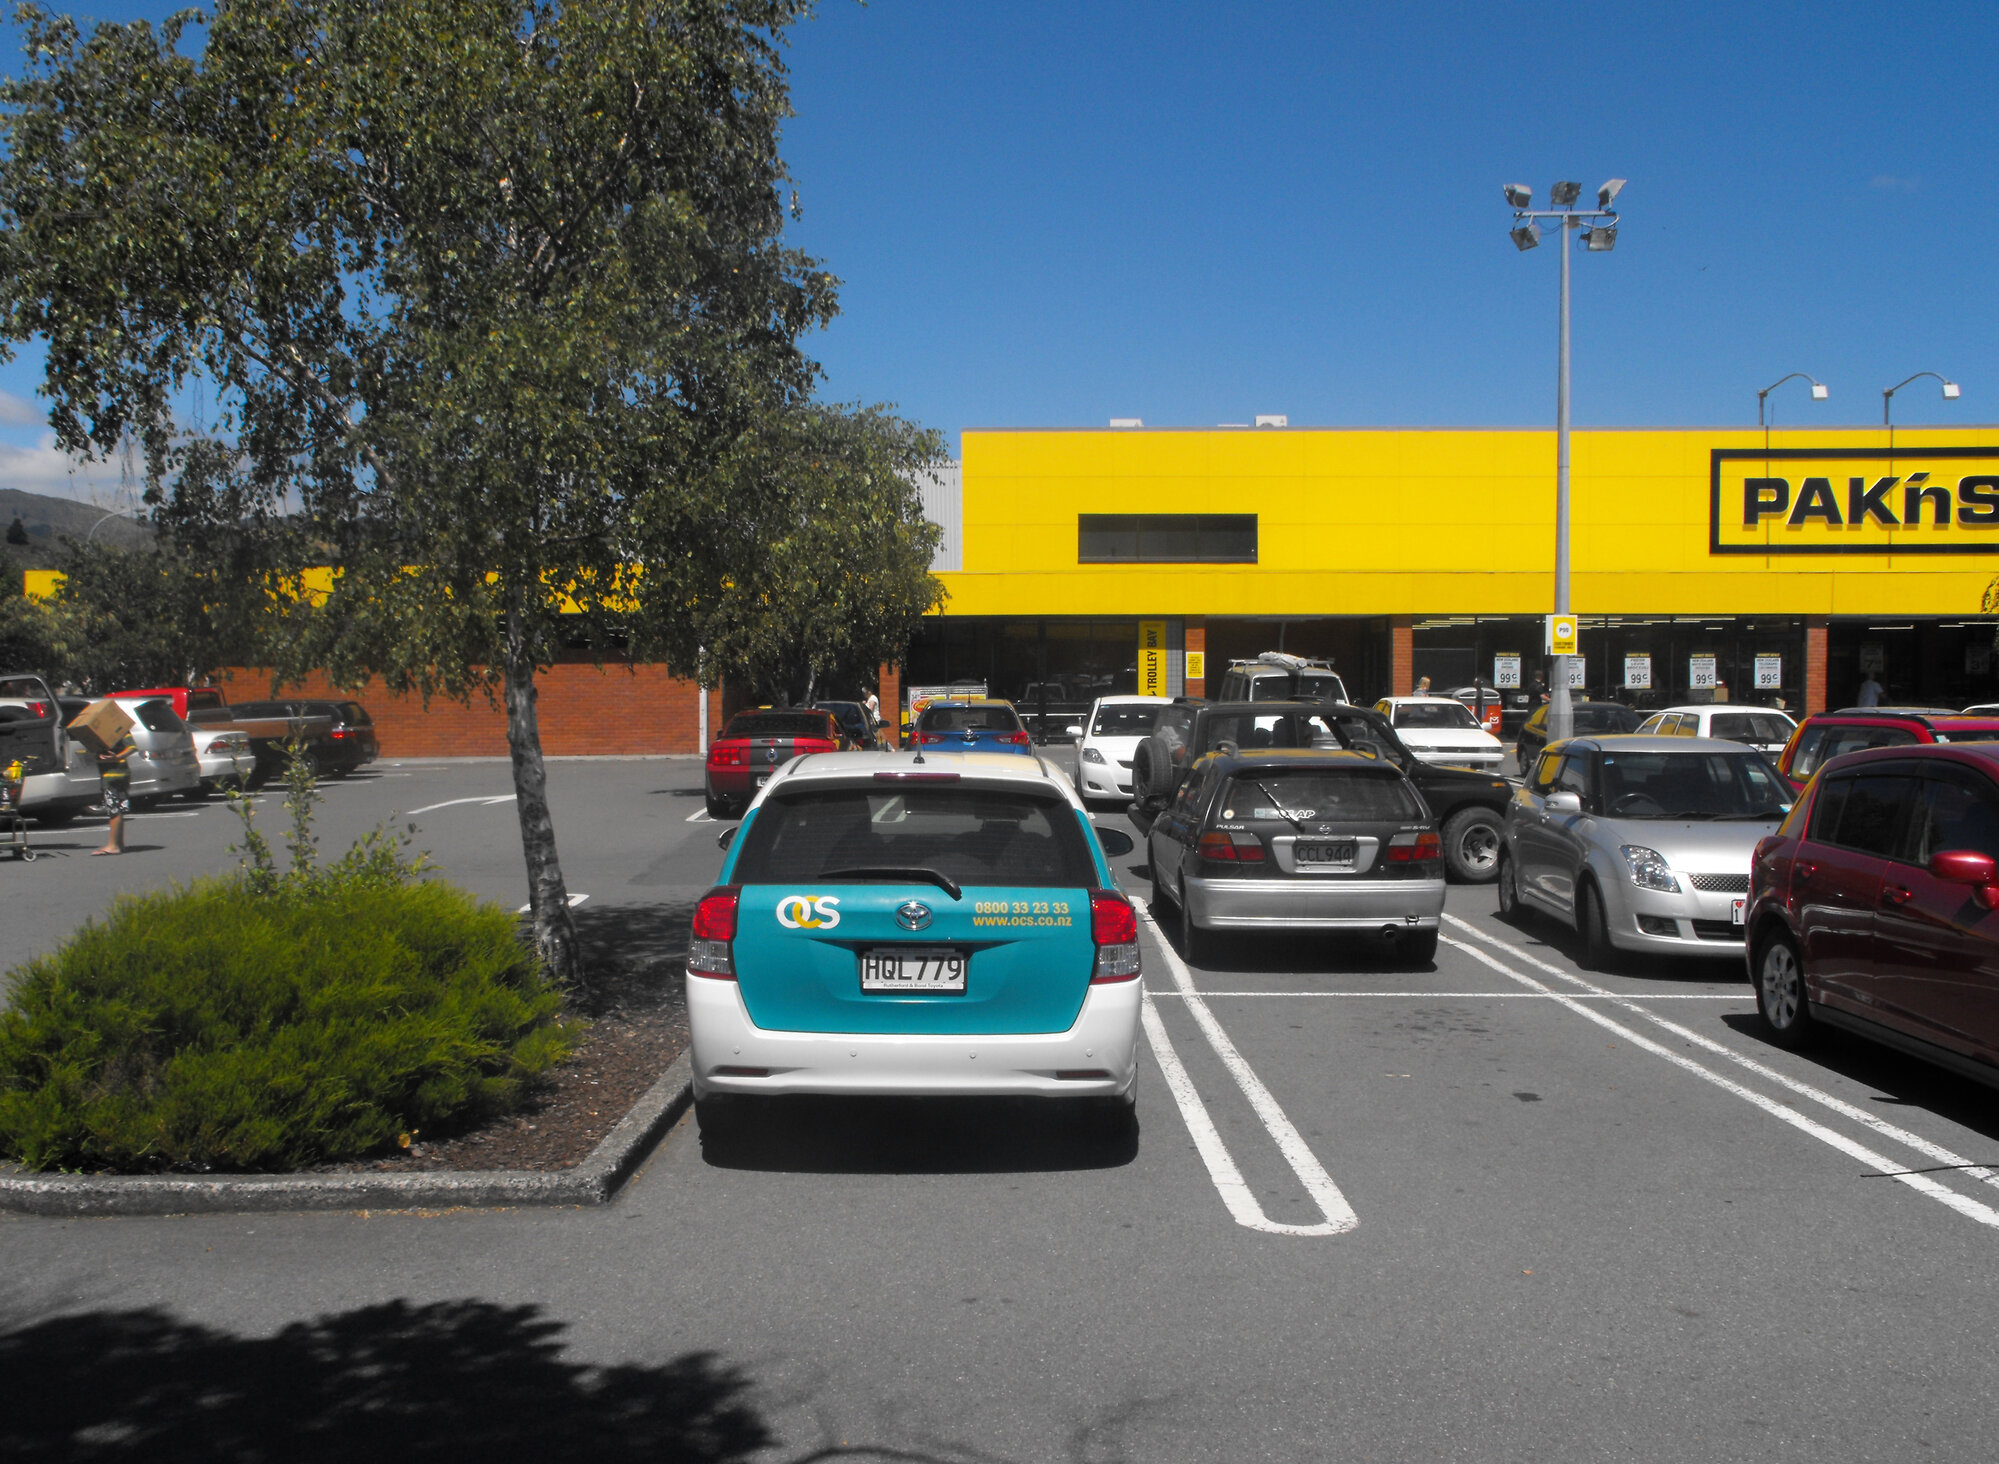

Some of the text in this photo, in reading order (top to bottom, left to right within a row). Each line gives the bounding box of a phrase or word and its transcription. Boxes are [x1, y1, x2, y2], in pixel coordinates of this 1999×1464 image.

[1146, 629, 1158, 648] BAY
[1146, 650, 1158, 690] TROLLEY
[776, 895, 841, 929] OCS
[975, 902, 1069, 914] 0800 33 23 33
[973, 916, 1072, 927] www.ocs.co.nz
[865, 955, 962, 981] HQL779
